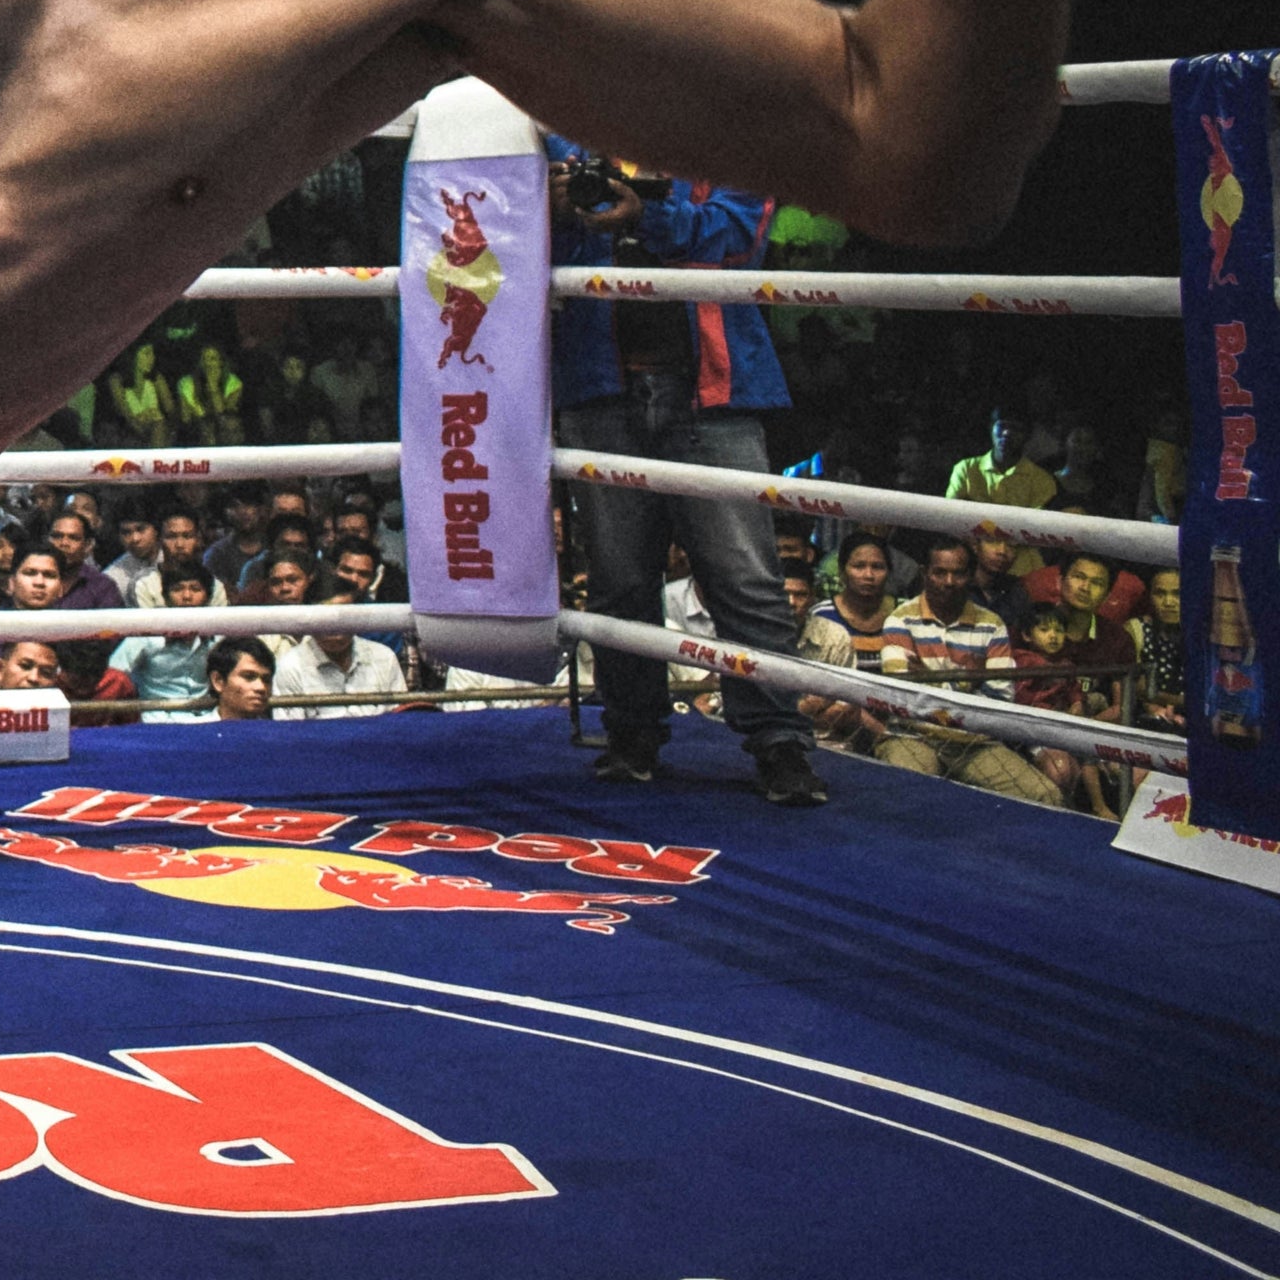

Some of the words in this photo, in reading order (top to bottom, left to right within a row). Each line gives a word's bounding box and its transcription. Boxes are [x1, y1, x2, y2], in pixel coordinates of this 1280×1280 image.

[1213, 320, 1254, 410] Red
[153, 459, 180, 474] Red
[183, 459, 210, 474] Bull
[440, 390, 489, 484] Red
[443, 489, 495, 582] Bull
[6, 786, 358, 844] Bull
[353, 819, 721, 885] Red
